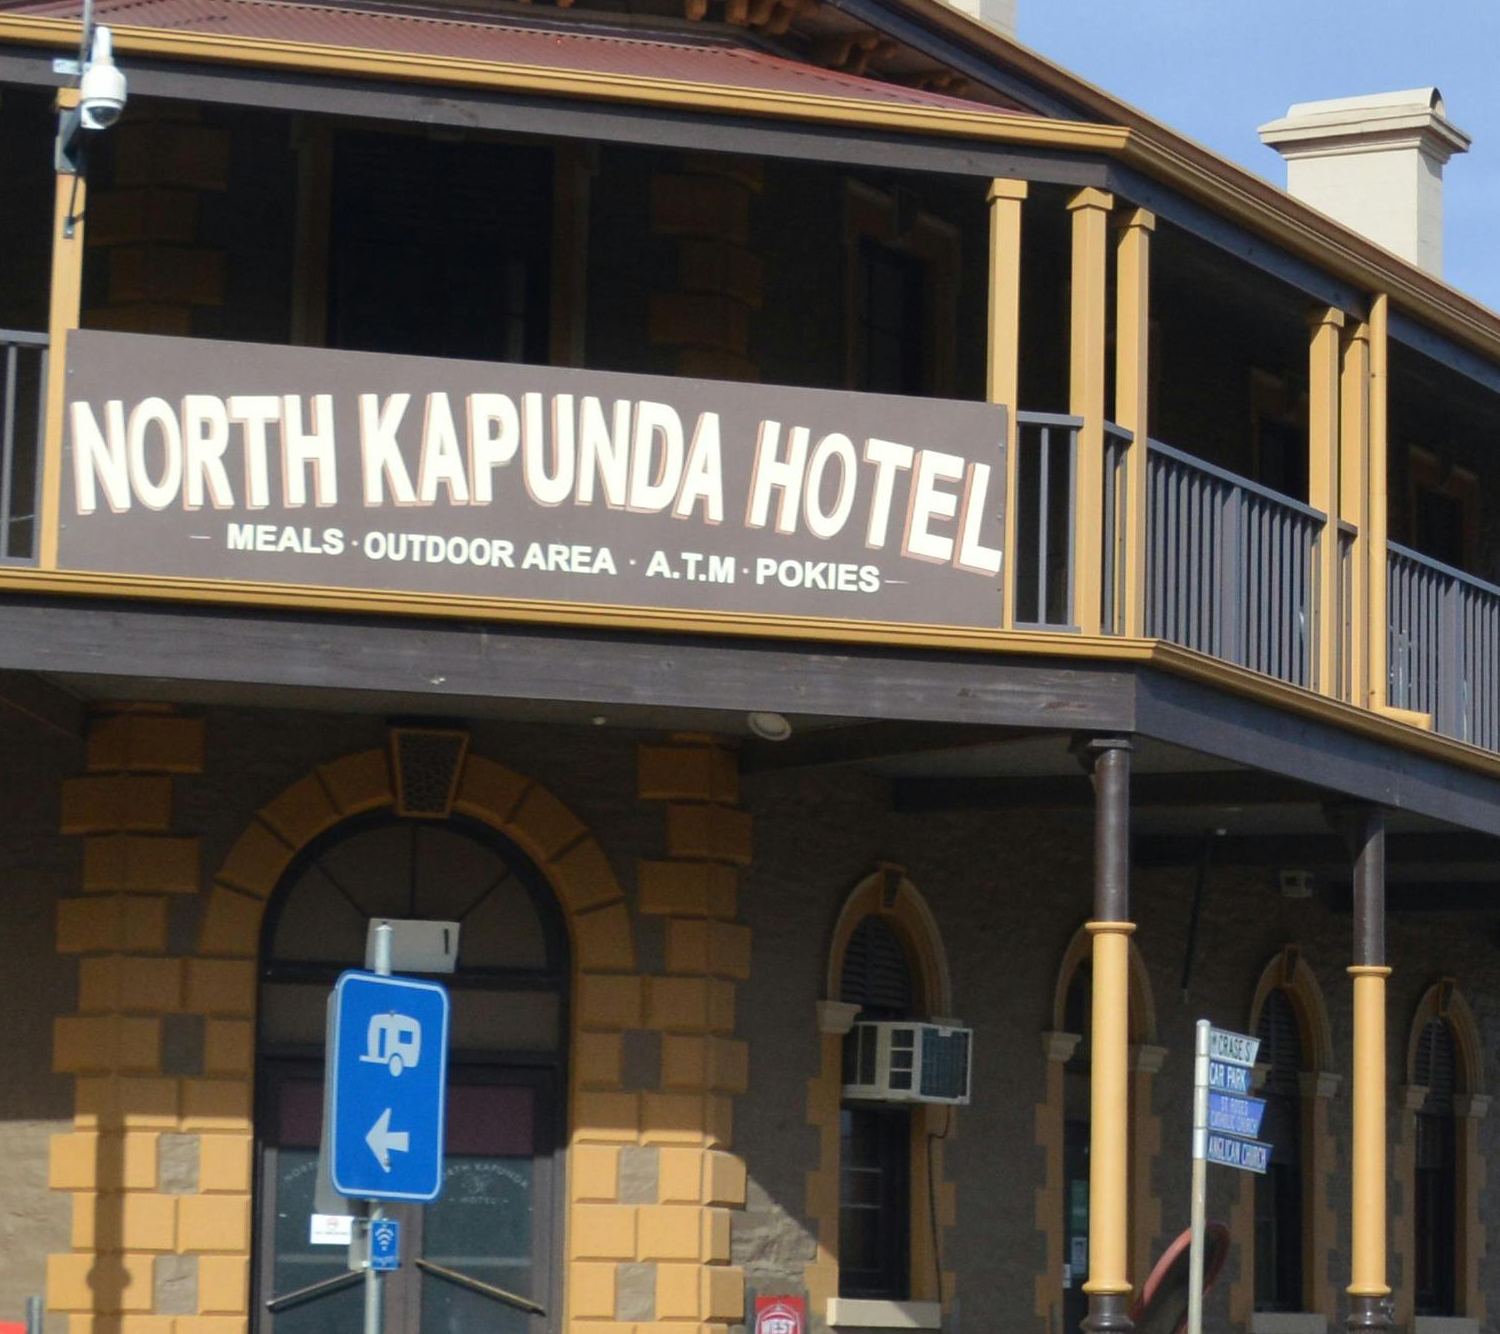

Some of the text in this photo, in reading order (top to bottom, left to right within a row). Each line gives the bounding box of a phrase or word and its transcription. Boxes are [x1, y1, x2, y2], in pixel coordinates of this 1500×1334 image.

[70, 391, 1002, 577] NORTH KAPUNDA HOTEL
[226, 523, 881, 593] MEALS OUTDOOR AREA A.T.M POKIES
[1218, 1034, 1244, 1060] CRASE
[1209, 1061, 1247, 1092] CAR PARK
[1241, 1143, 1267, 1172] CHURCH
